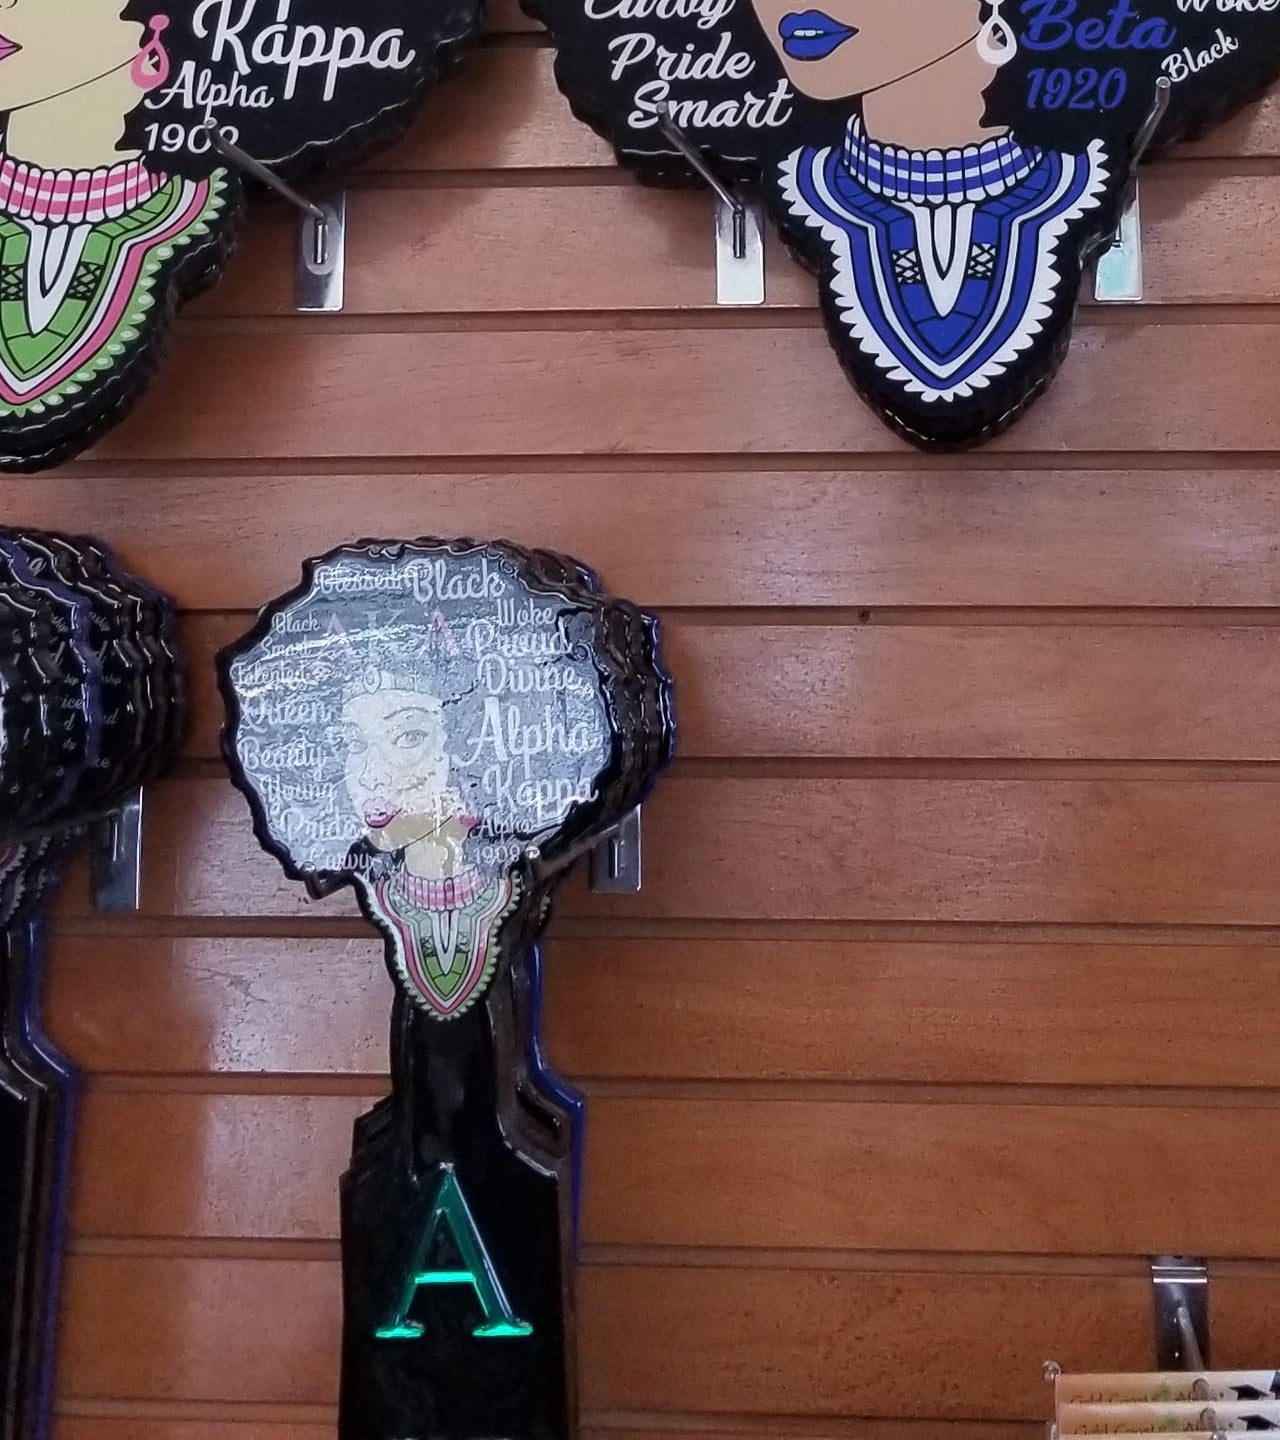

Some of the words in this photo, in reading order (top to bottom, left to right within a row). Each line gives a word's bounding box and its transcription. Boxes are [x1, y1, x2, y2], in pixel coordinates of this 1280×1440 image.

[609, 32, 755, 80] Pride
[1161, 28, 1238, 82] Black
[144, 61, 274, 125] Alpha
[628, 78, 793, 128] Smart
[1028, 68, 1126, 109] 1920
[376, 1163, 533, 1340] A
